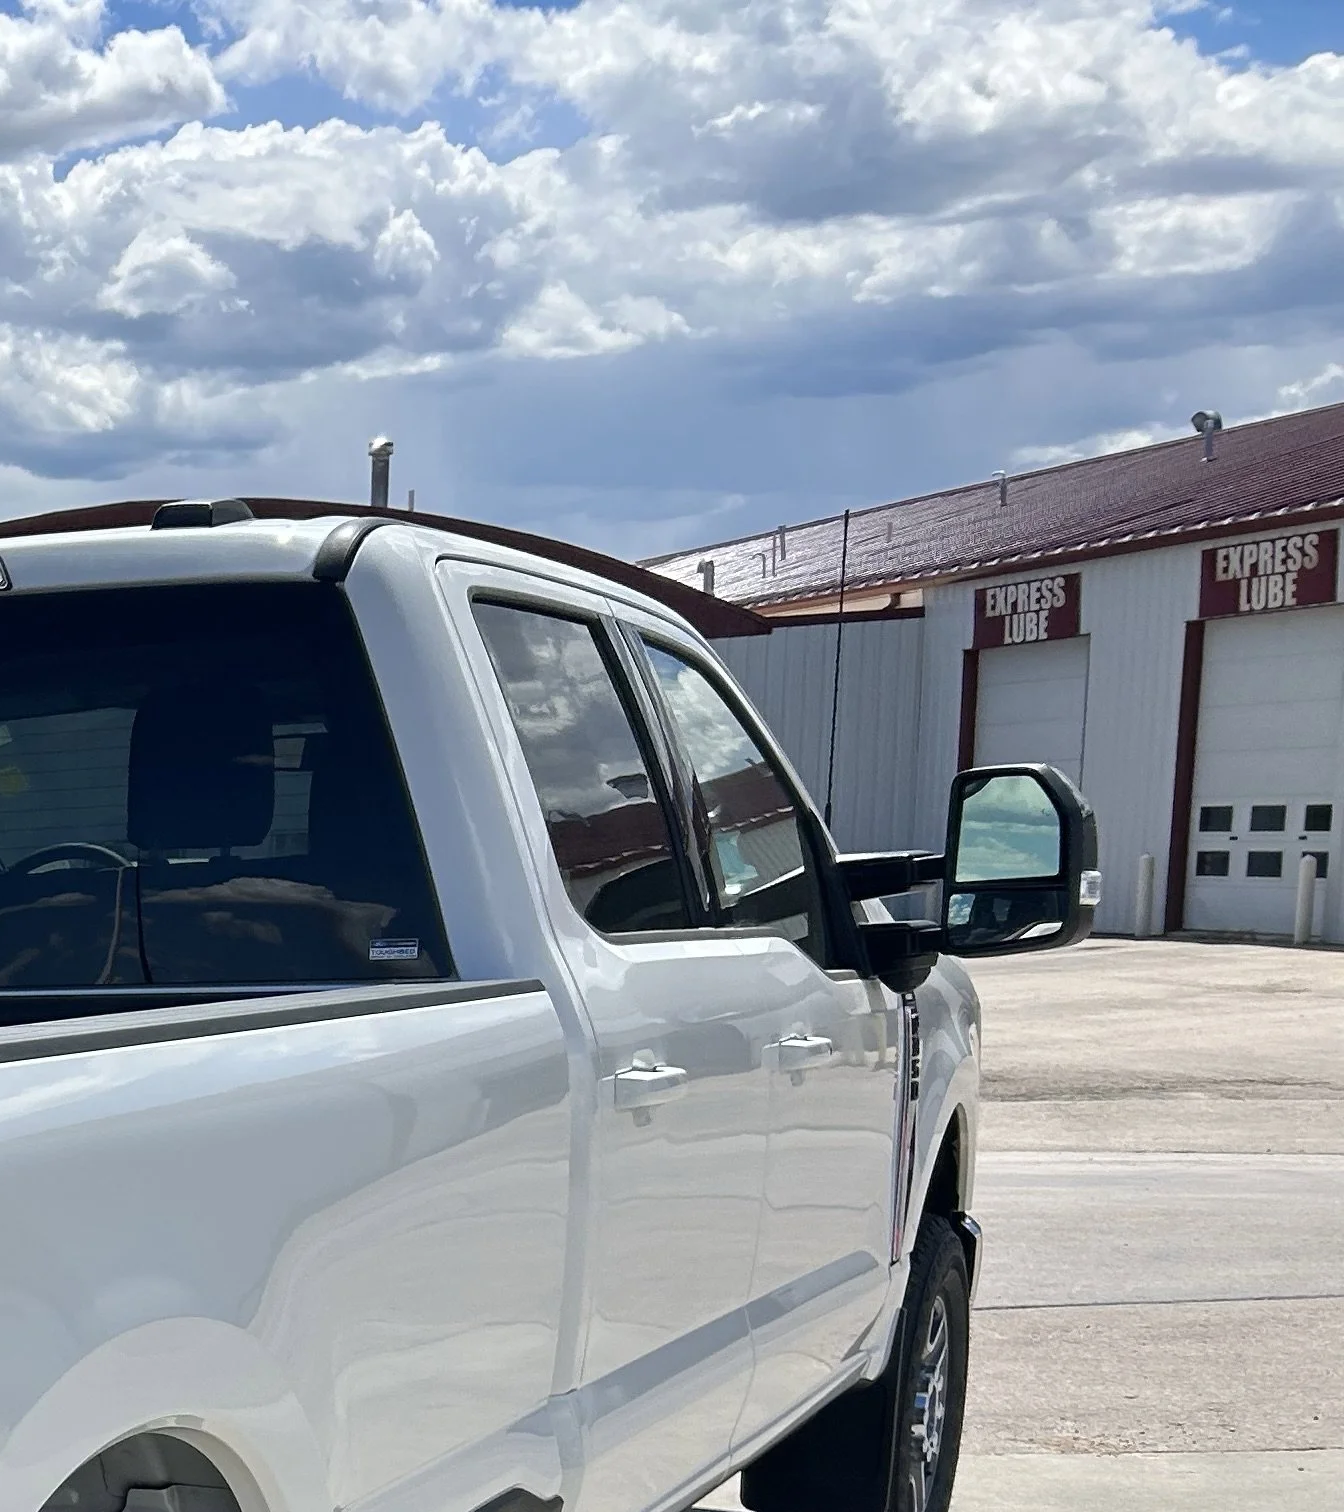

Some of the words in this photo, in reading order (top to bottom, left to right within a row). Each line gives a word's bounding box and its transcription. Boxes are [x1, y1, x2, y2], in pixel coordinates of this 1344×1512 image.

[1215, 533, 1320, 581] EXPRESS
[985, 576, 1066, 618] EXPRESS
[1239, 571, 1299, 613] LUBE
[1003, 610, 1049, 645] LUBE
